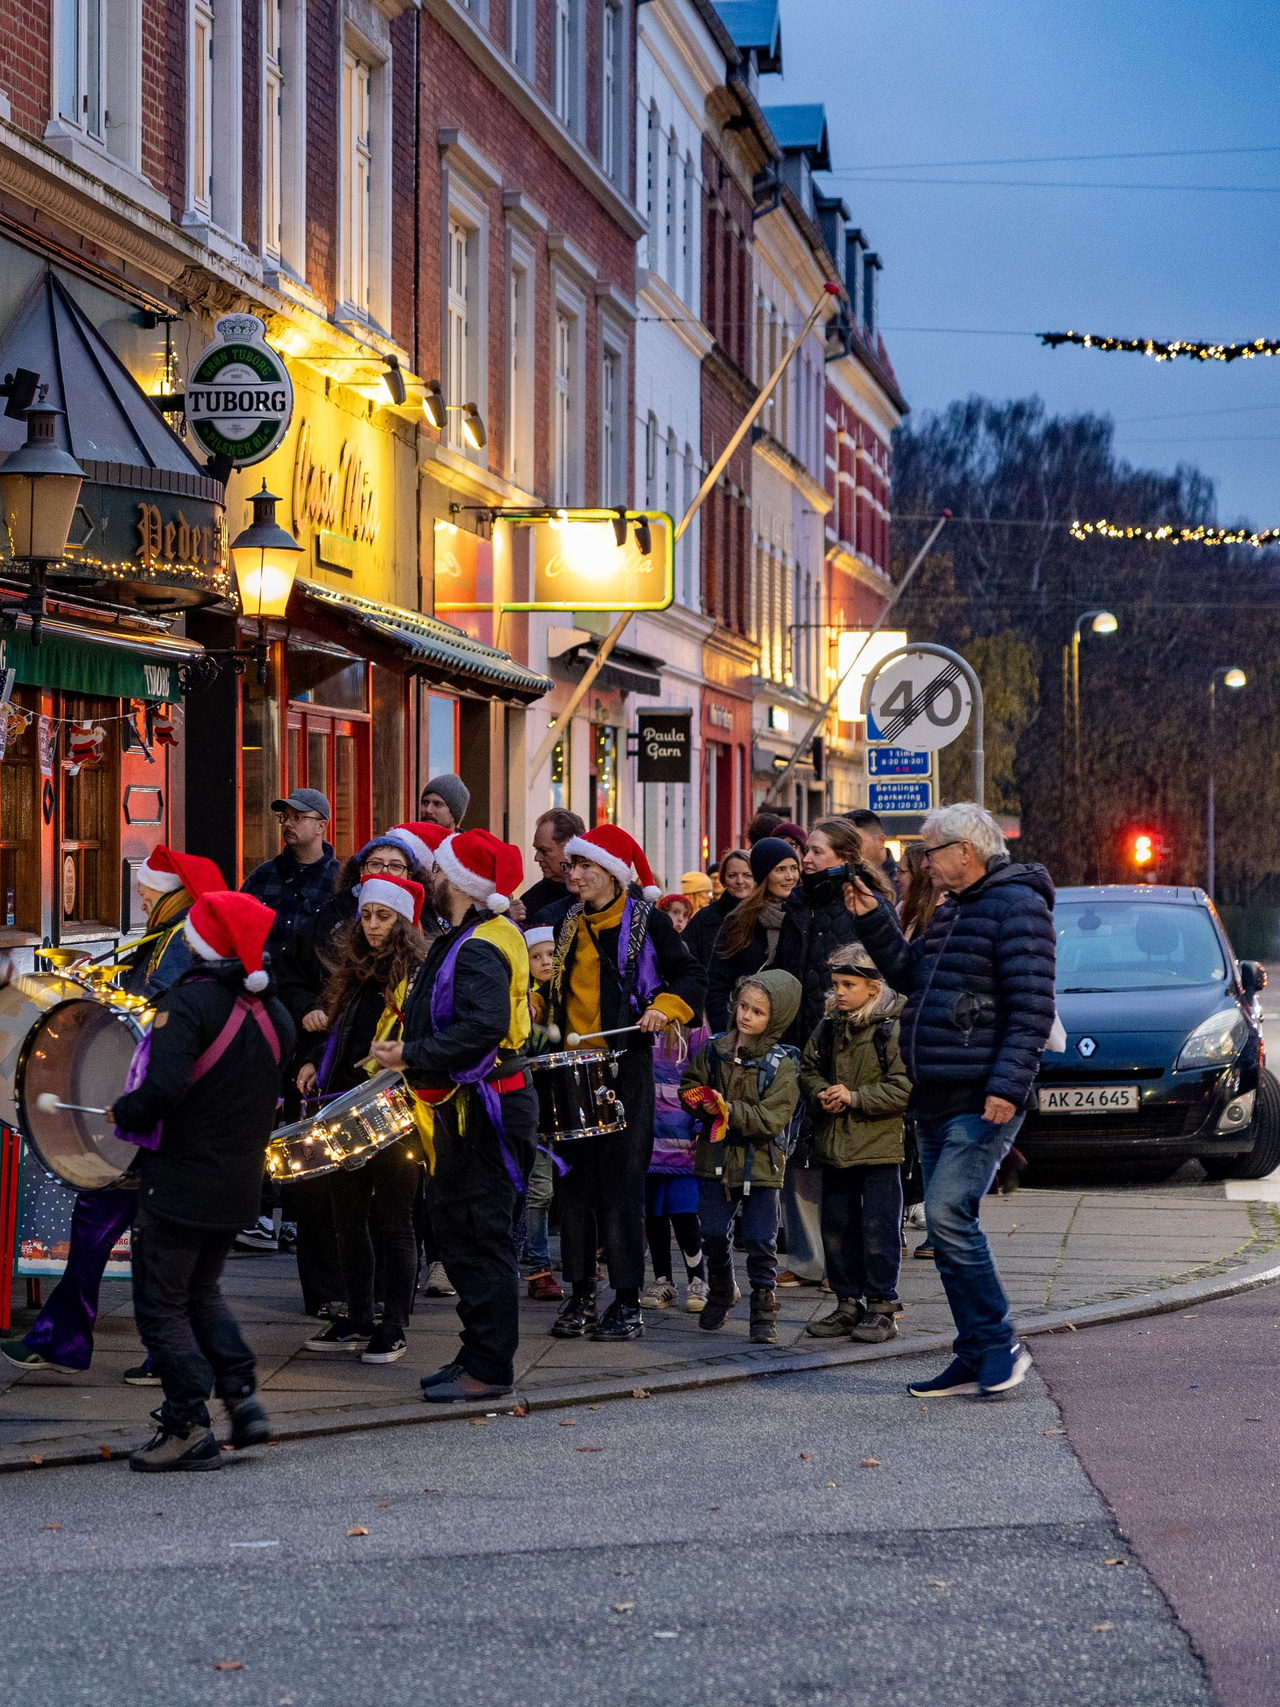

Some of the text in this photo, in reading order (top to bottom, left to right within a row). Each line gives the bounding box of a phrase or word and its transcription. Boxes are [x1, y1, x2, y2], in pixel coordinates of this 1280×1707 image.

[202, 349, 272, 377] GRØN TUBORG
[189, 390, 286, 413] TUBORG
[207, 432, 268, 456] PILSNER ØL
[135, 502, 211, 566] Peder
[880, 680, 962, 727] 40
[643, 727, 685, 742] Paula
[646, 743, 681, 760] Garn
[878, 794, 921, 802] parkering
[1048, 1090, 1130, 1107] AK 24 645
